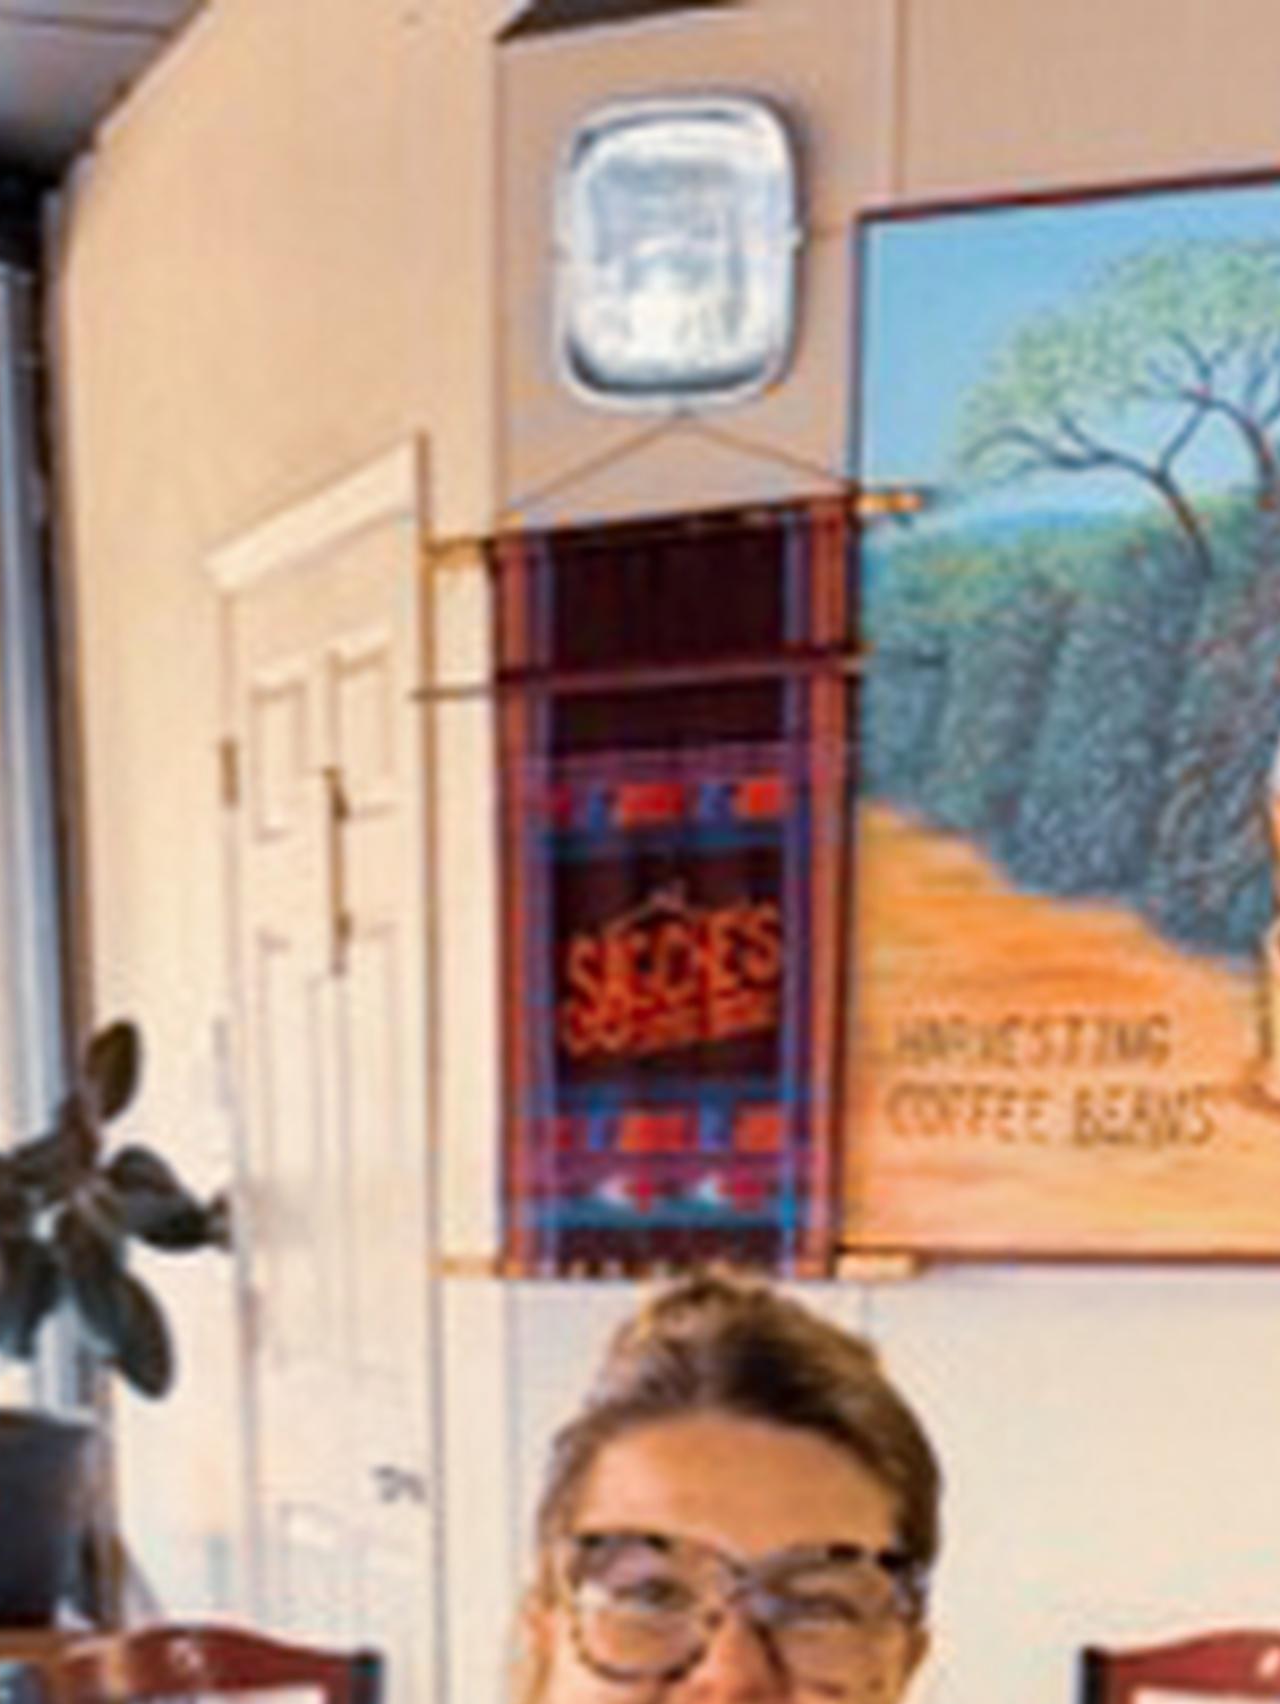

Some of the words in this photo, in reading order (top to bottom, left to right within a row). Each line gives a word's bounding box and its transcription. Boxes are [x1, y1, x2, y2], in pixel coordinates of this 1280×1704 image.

[894, 1012, 1171, 1068] HARVESTING
[883, 1081, 1051, 1144] COFFEE
[1070, 1081, 1218, 1148] BEANS
